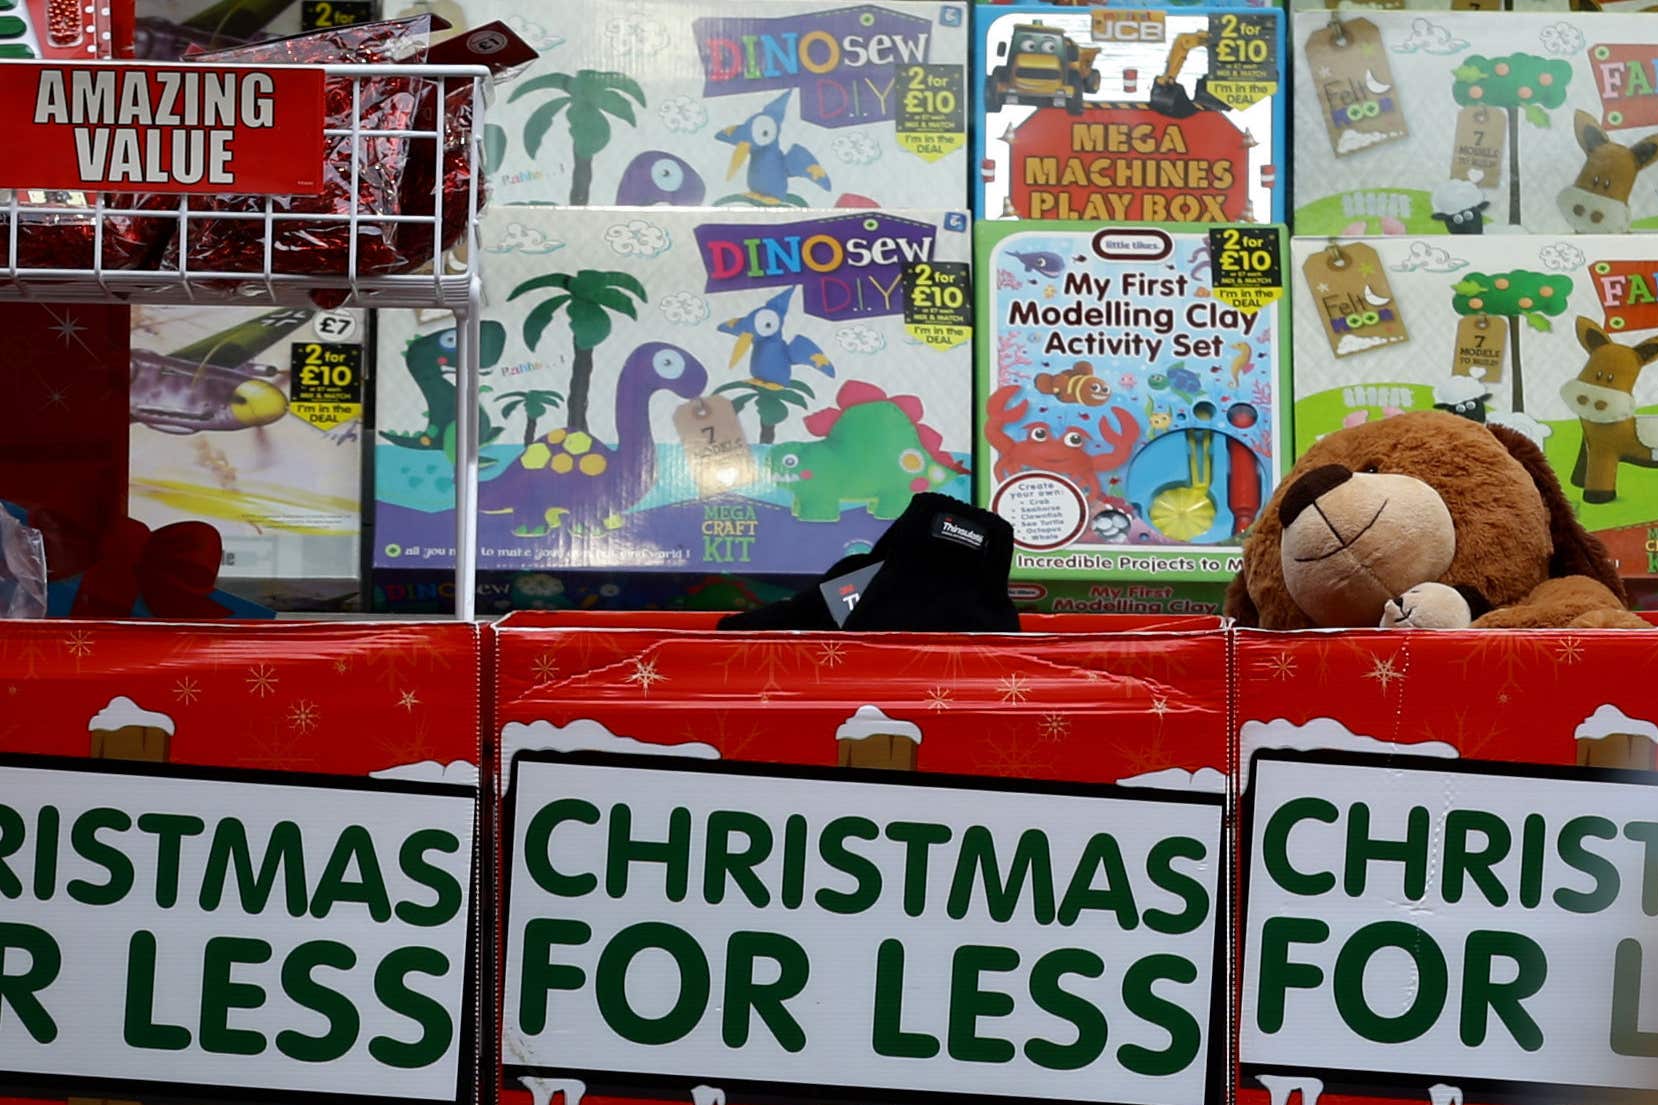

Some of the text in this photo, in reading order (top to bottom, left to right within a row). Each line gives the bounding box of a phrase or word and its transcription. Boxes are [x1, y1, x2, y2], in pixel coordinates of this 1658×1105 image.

[1093, 21, 1163, 41] JCB
[1221, 14, 1262, 38] 2 for
[478, 37, 500, 50] £1
[1216, 39, 1267, 63] £10
[908, 66, 949, 89] 2 for
[34, 69, 274, 128] AMAZING
[904, 90, 956, 114] £10
[1072, 123, 1187, 153] MEGA
[74, 127, 235, 184] VALUE
[1025, 157, 1235, 190] MACHINES
[1031, 191, 1229, 222] PLAY BOX
[1223, 229, 1264, 250] 2 for
[1219, 250, 1272, 271] £10
[915, 264, 956, 285] 2 for
[911, 286, 964, 309] £10
[1064, 272, 1188, 302] My First
[1219, 289, 1274, 298] I'm in the
[1232, 298, 1262, 308] DEAL
[320, 316, 351, 335] £7
[1008, 300, 1259, 336] Modelling Clay
[914, 326, 964, 336] I'm in the
[926, 336, 953, 345] DEAL
[1473, 335, 1486, 348] 7
[305, 344, 346, 365] 2 for
[1044, 332, 1225, 362] Activity Set
[299, 365, 352, 386] £10
[309, 414, 340, 423] DEAL
[320, 405, 330, 413] in
[333, 405, 352, 413] the
[701, 427, 715, 445] 7
[704, 506, 757, 520] MEGA
[702, 521, 758, 536] CRAFT
[703, 536, 756, 562] KIT
[1017, 555, 1113, 569] Incredible
[1119, 557, 1195, 573] Projects
[1200, 559, 1221, 571] to
[1089, 586, 1174, 602] My First
[1053, 600, 1218, 614] Modelling Clay
[524, 797, 1210, 934] CHRISTMAS
[1256, 916, 1548, 1053] FOR
[123, 929, 454, 1069] LESS
[518, 917, 1202, 1077] FOR LESS
